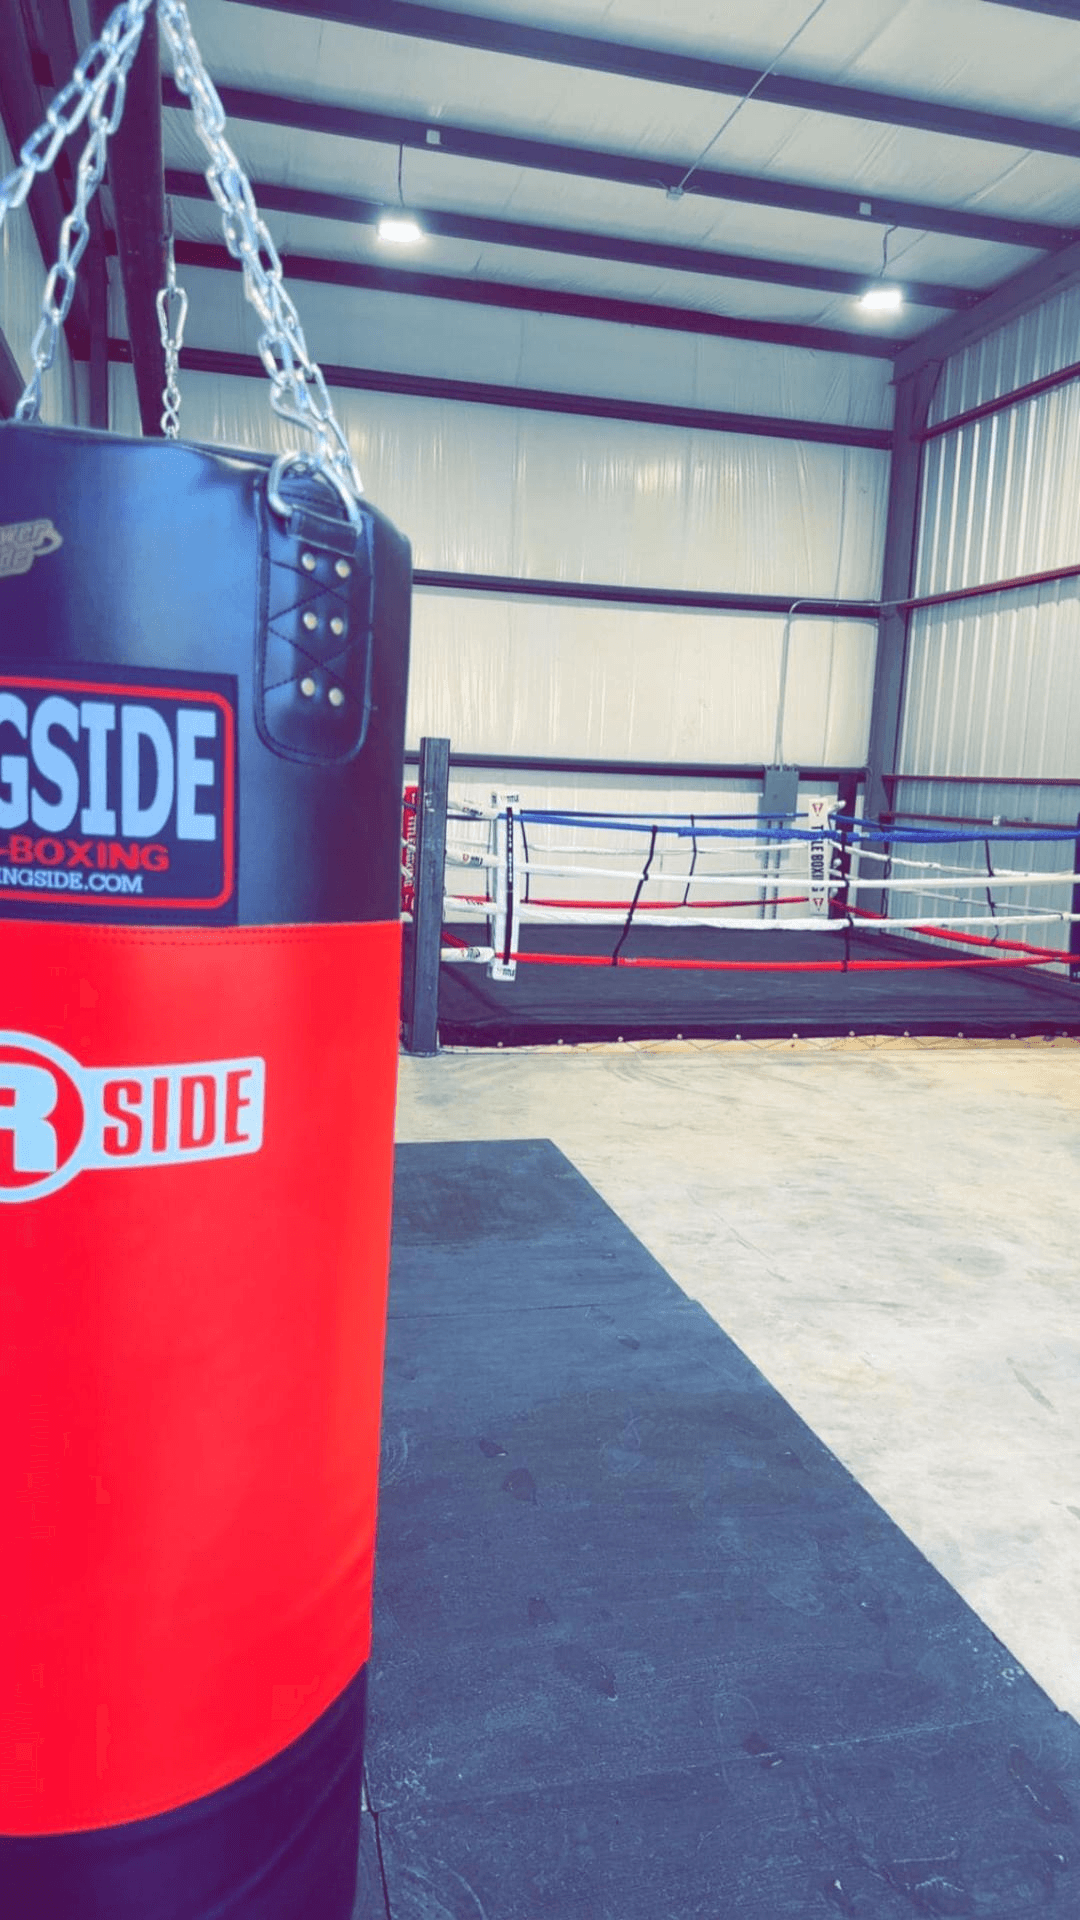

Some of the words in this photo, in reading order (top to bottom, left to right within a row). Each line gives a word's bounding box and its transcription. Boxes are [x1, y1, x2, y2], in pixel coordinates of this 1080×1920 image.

[811, 825, 824, 852] TLE
[0, 867, 143, 893] NGSIDE.COM
[811, 854, 824, 892] BOXIG
[103, 1069, 252, 1157] SIDE
